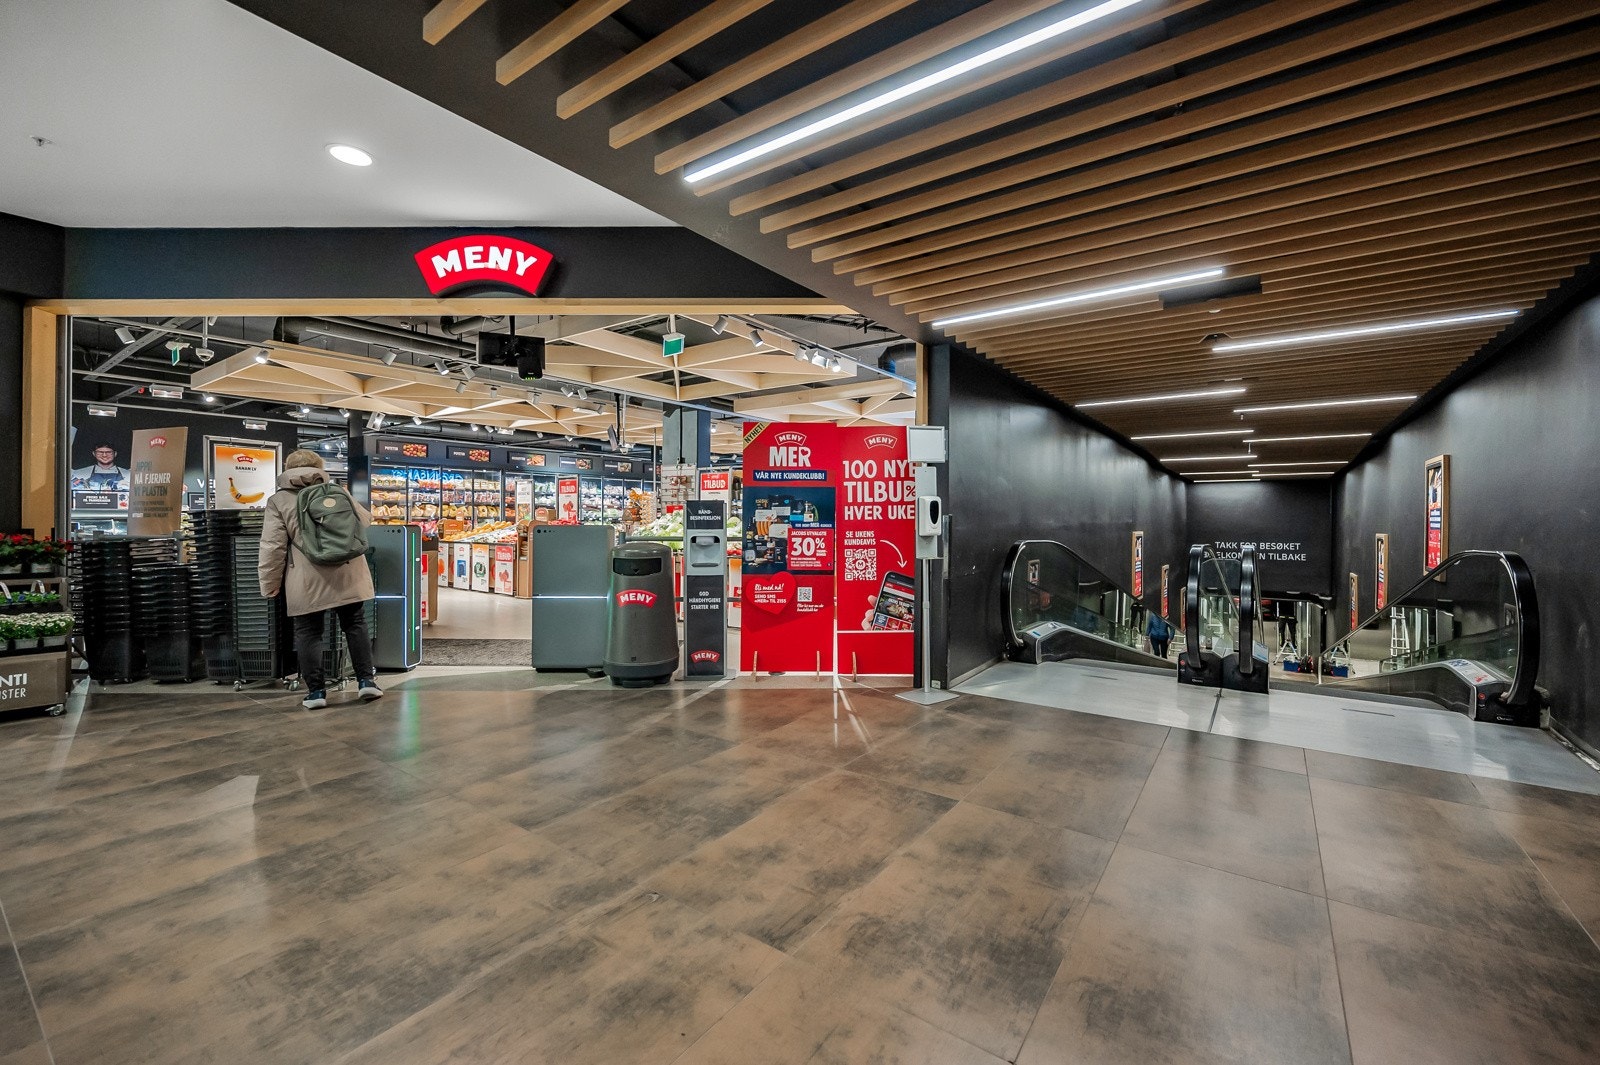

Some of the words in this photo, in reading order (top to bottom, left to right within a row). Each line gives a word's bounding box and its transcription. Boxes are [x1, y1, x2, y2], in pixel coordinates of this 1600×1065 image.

[431, 245, 538, 279] MENY
[744, 423, 765, 443] NYHET!
[778, 433, 804, 442] MENY
[150, 438, 166, 446] MENY
[868, 436, 894, 445] MENY
[769, 446, 812, 467] MER
[842, 459, 878, 479] 100
[134, 473, 143, 484] NÅ
[144, 472, 171, 484] FJERNER
[755, 471, 769, 479] VÅR
[783, 472, 825, 480] KUNDEKLUBB!
[703, 479, 726, 489] TILBUD
[141, 485, 168, 497] PLASTEN
[844, 505, 883, 520] HVER
[887, 504, 915, 520] UKE
[790, 537, 826, 557] 30%
[844, 538, 876, 546] KUNDEAVIS
[1214, 541, 1238, 549] TAKK
[1259, 542, 1301, 551] BESØKET
[1267, 553, 1307, 561] TILBAKE
[620, 592, 653, 603] MENY
[694, 652, 717, 660] MENY
